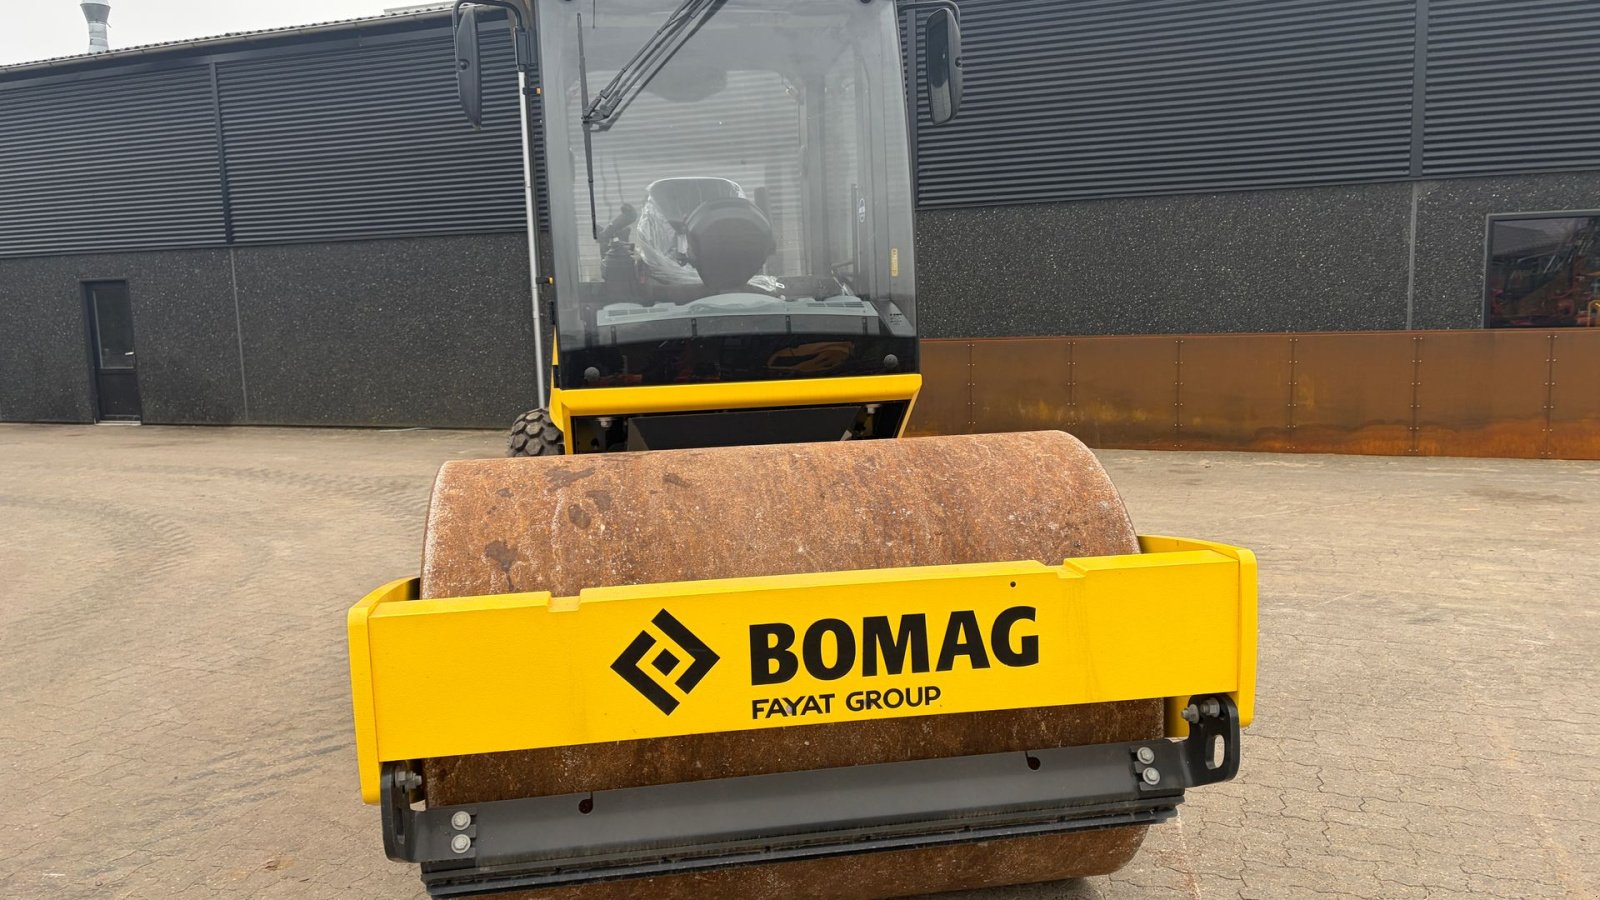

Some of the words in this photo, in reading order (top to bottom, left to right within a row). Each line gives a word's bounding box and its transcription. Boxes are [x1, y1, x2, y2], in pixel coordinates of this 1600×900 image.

[749, 605, 1039, 686] BOMAG
[752, 693, 835, 720] FAYAT
[845, 686, 941, 712] GROUP
